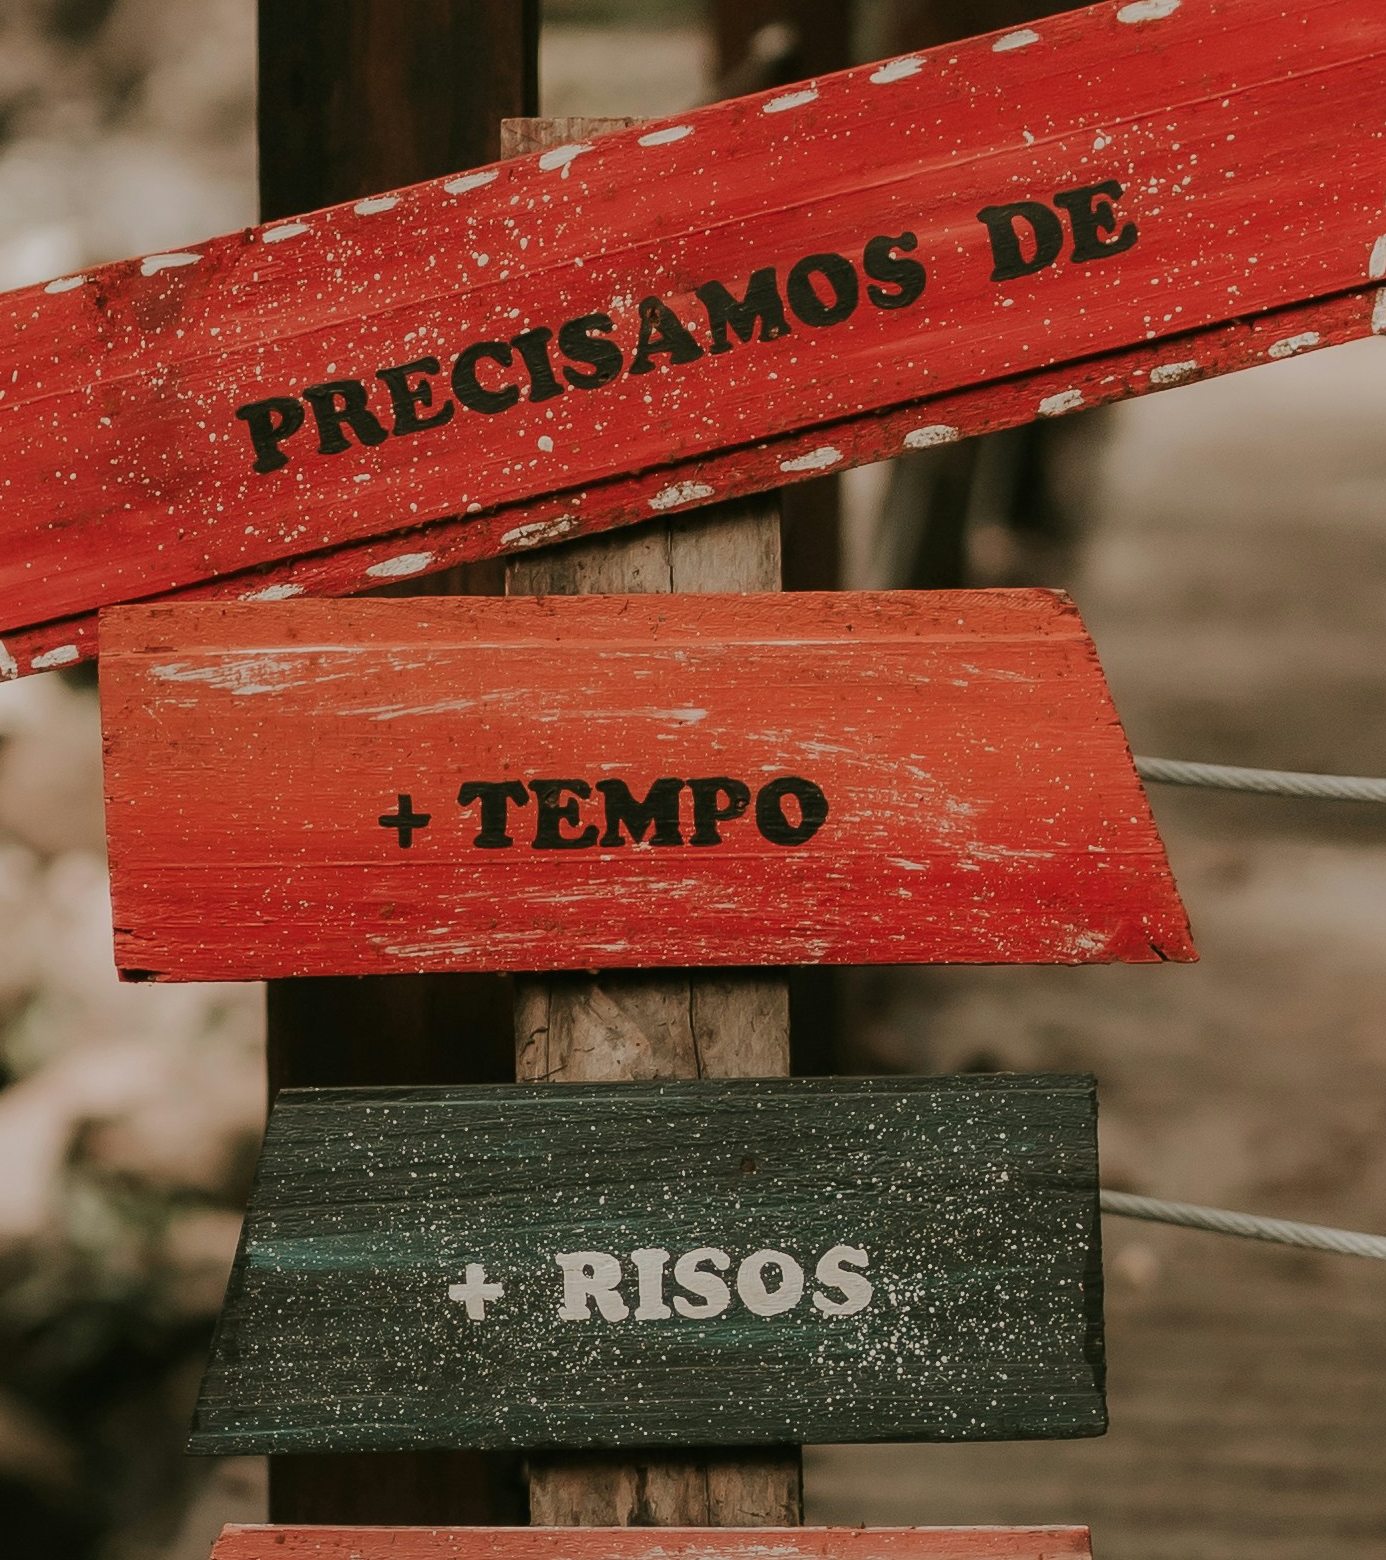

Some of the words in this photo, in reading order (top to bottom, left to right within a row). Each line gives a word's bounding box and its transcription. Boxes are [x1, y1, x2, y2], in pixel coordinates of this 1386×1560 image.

[236, 231, 926, 474] PRECISAMOS
[976, 179, 1138, 282] DE
[379, 793, 430, 848] +
[459, 776, 829, 849] TEMPO
[448, 1263, 502, 1321] +
[556, 1244, 874, 1322] RISOS
